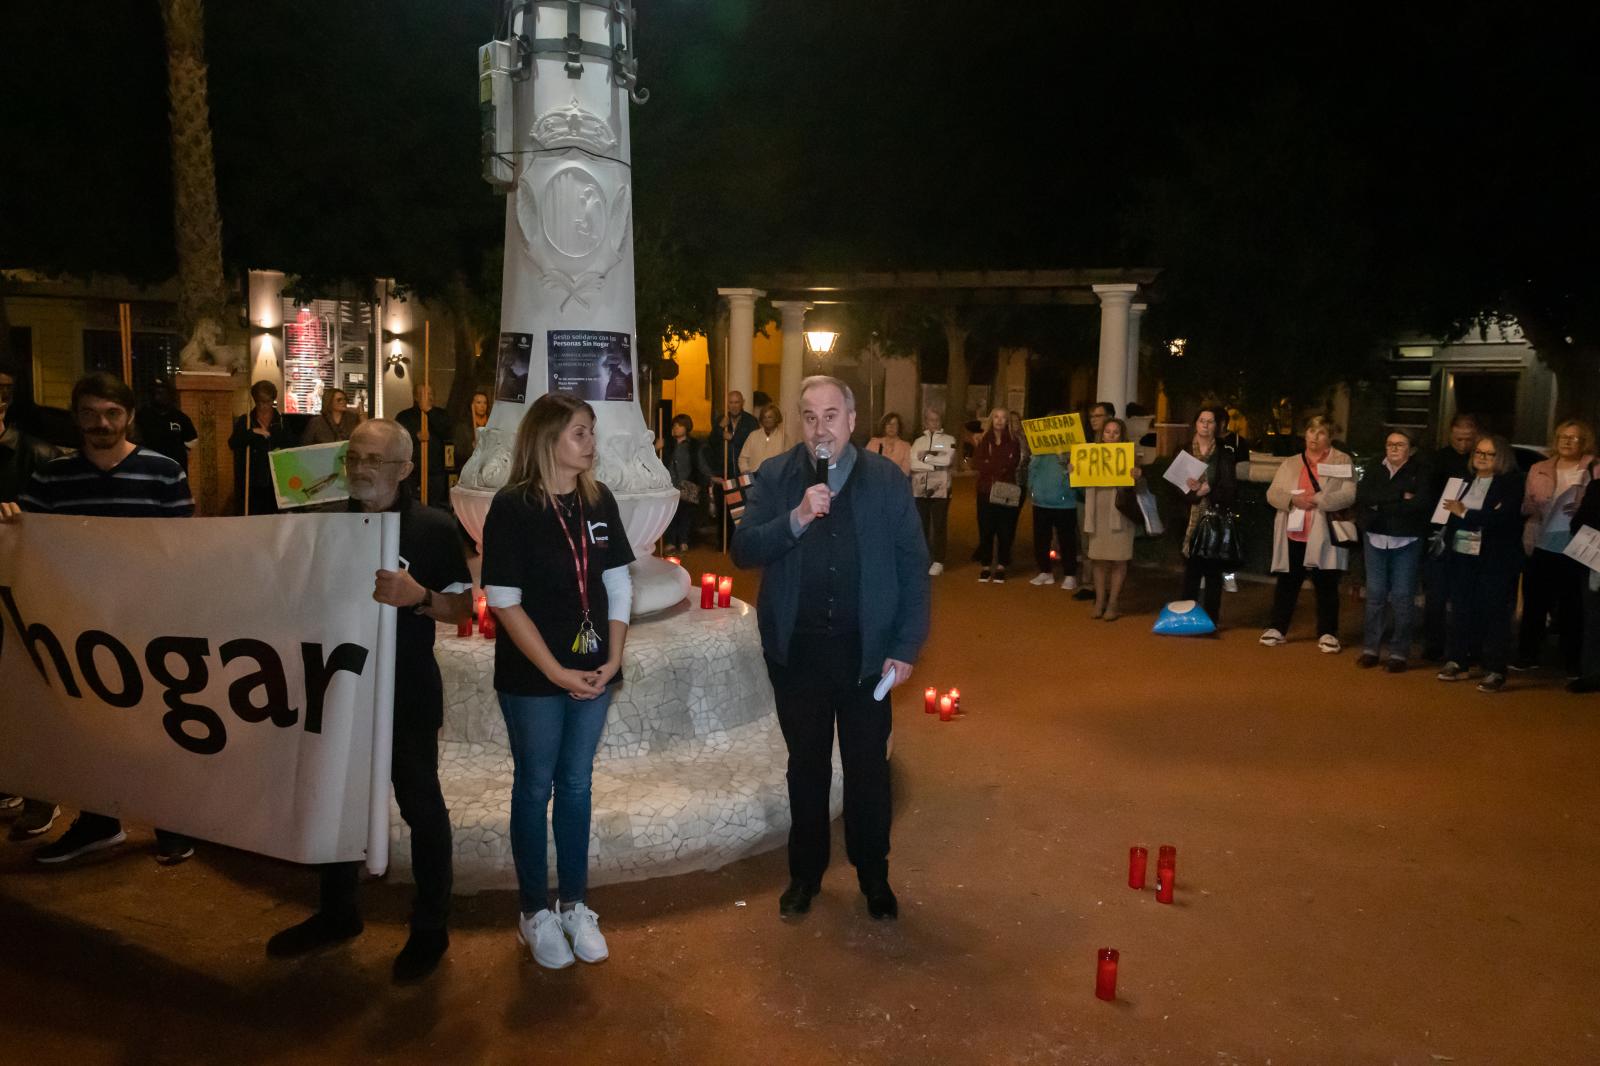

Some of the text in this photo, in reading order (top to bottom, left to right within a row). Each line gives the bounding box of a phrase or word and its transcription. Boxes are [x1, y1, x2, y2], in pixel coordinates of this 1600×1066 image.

[572, 333, 598, 341] solidario
[1076, 447, 1126, 476] PARO
[0, 586, 369, 754] hogar
